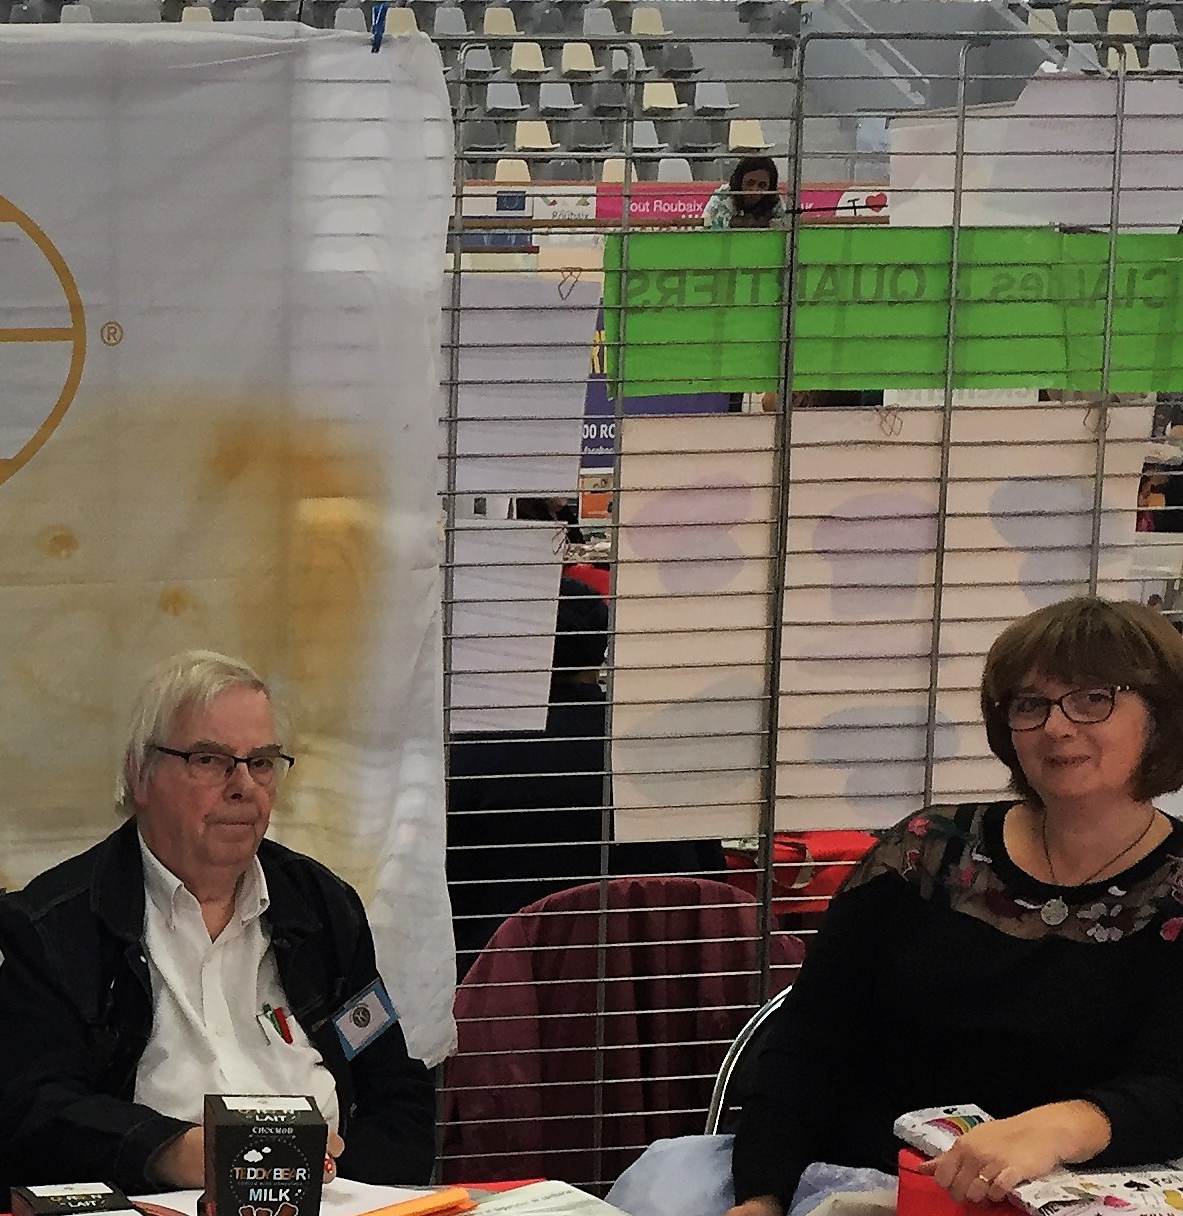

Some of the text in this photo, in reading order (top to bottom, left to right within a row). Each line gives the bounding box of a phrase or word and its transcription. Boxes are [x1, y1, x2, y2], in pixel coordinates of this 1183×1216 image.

[653, 200, 704, 213] Roubaix
[255, 1114, 287, 1122] LAIT
[234, 1167, 307, 1181] TEDDY BEAR
[249, 1188, 290, 1202] MILK
